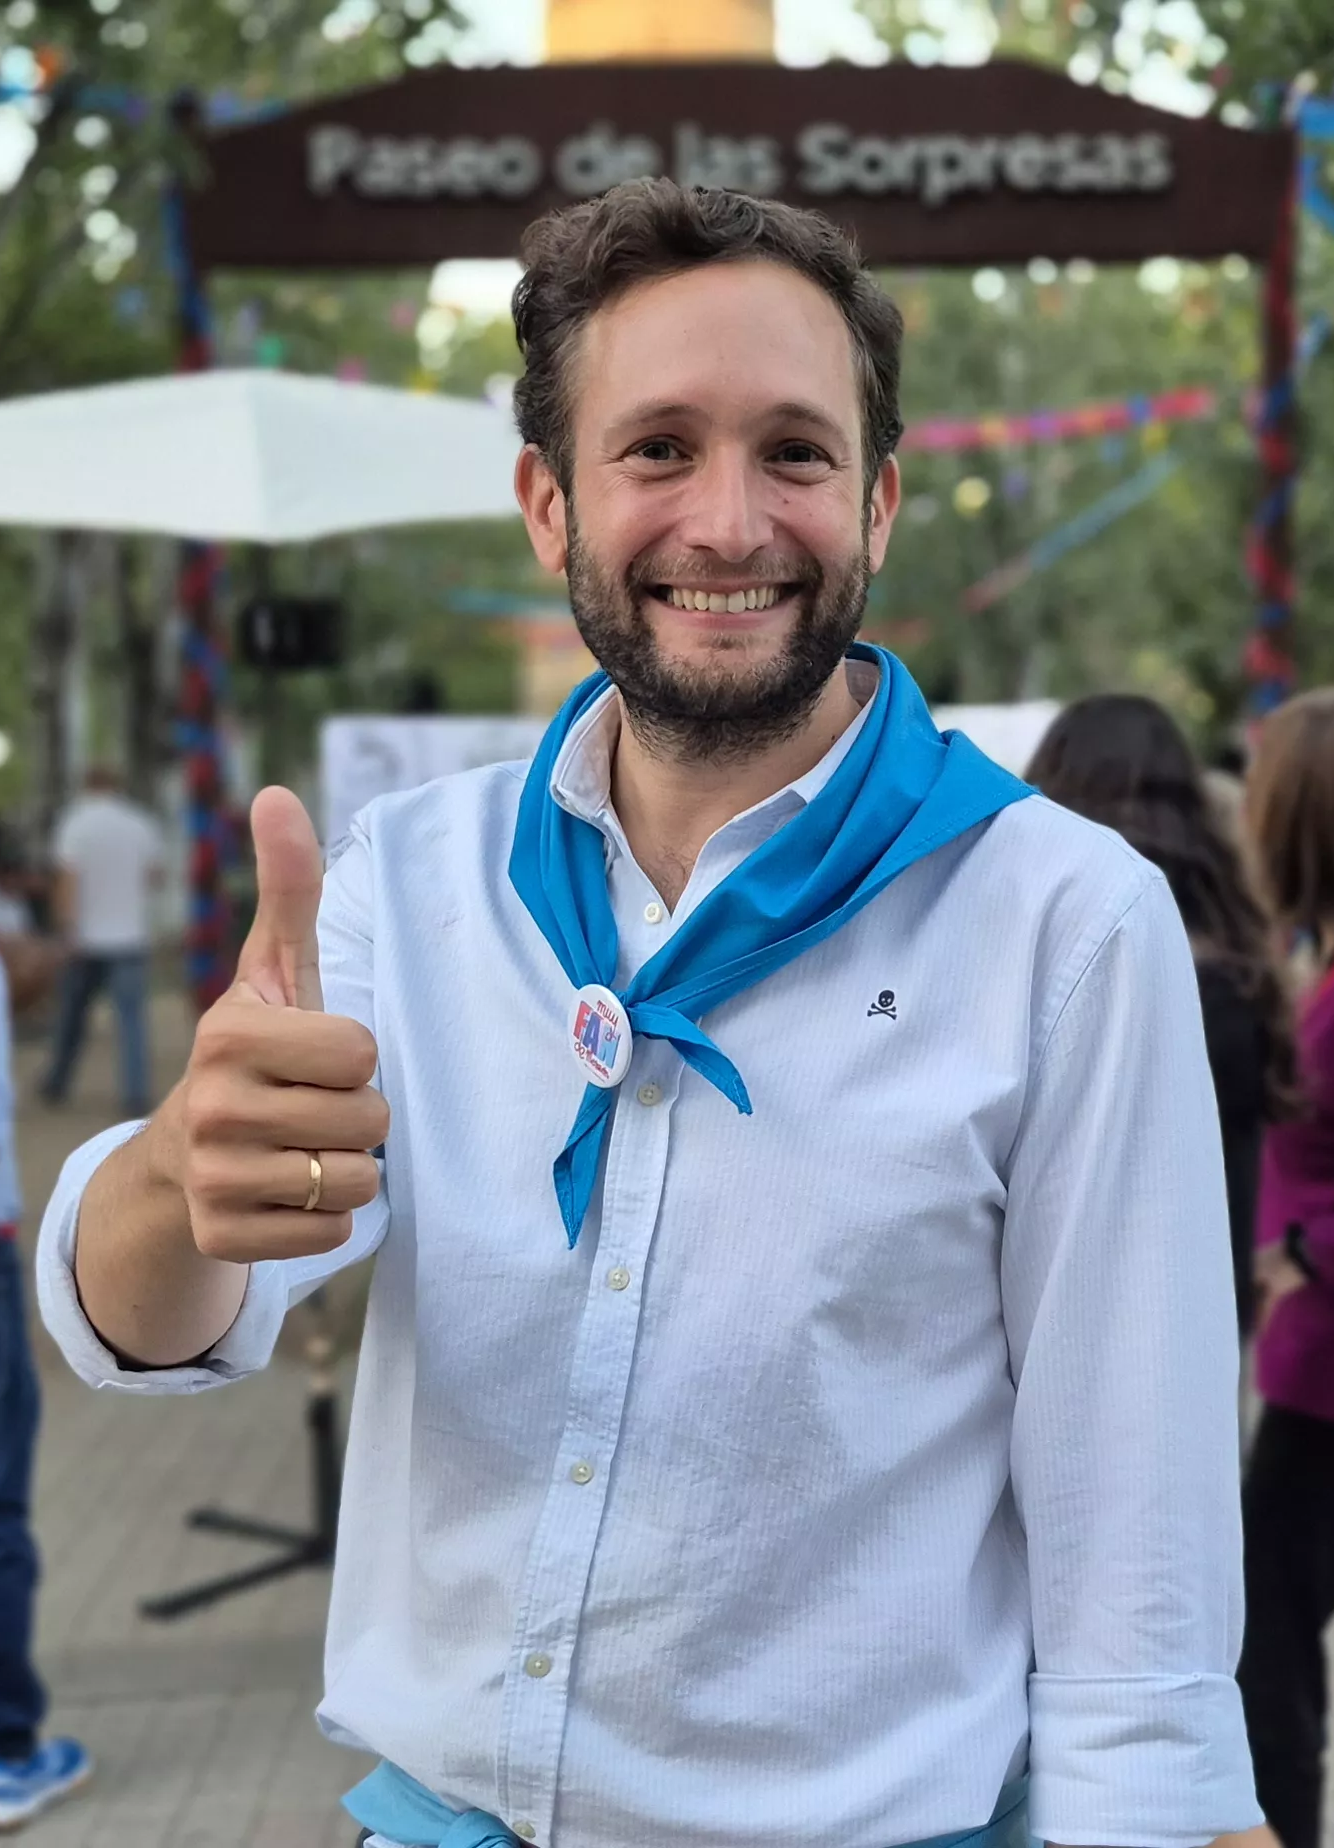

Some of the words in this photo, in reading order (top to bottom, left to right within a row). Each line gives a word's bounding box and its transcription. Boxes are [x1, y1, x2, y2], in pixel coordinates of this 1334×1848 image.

[309, 126, 537, 193] Paseo
[558, 121, 661, 192] de
[675, 122, 778, 191] las
[801, 125, 1167, 203] Sorpresas
[573, 1000, 621, 1069] FAN
[597, 1000, 619, 1042] muy
